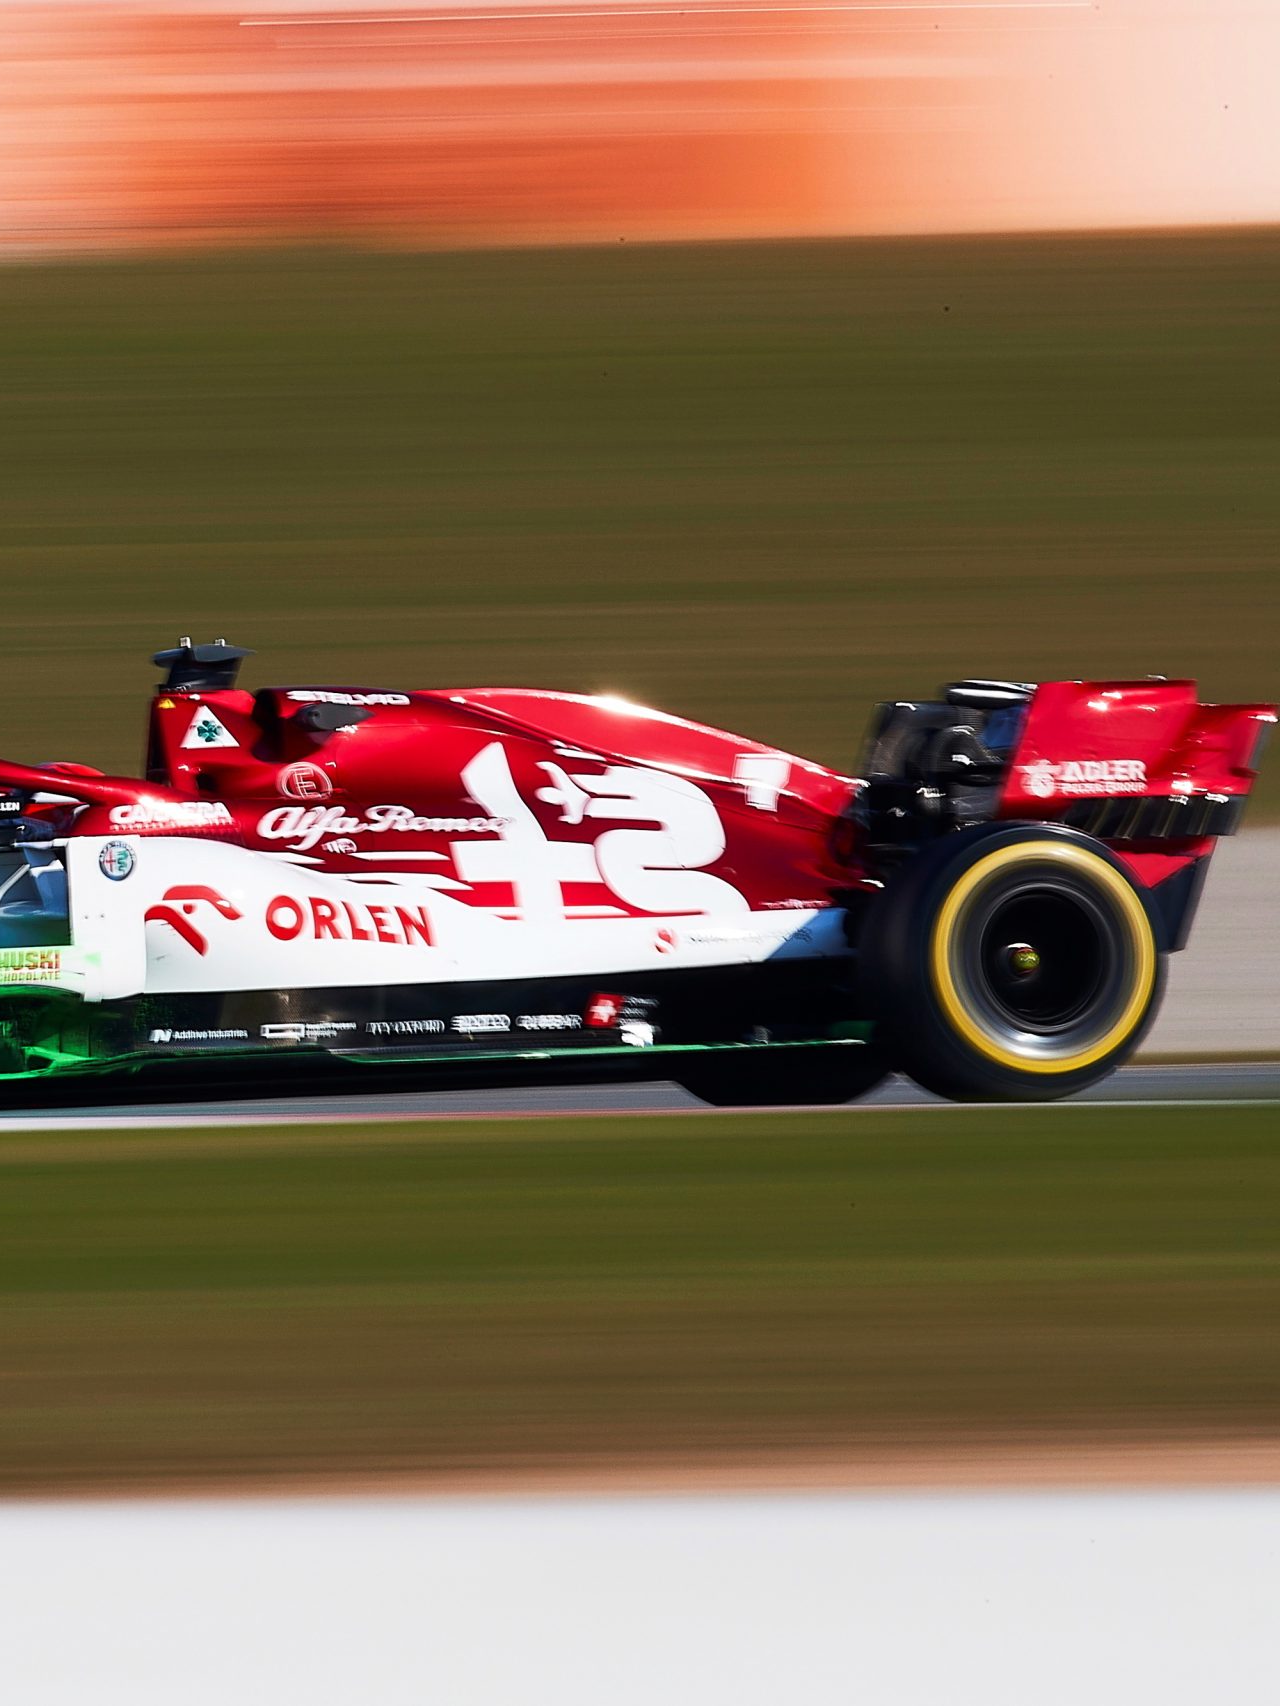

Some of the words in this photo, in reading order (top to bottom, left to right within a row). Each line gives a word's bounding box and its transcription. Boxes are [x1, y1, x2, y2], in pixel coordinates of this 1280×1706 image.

[1062, 760, 1148, 782] ADLER
[257, 806, 366, 850] Alfa
[365, 805, 515, 833] Romeo
[265, 894, 439, 947] ORLEN
